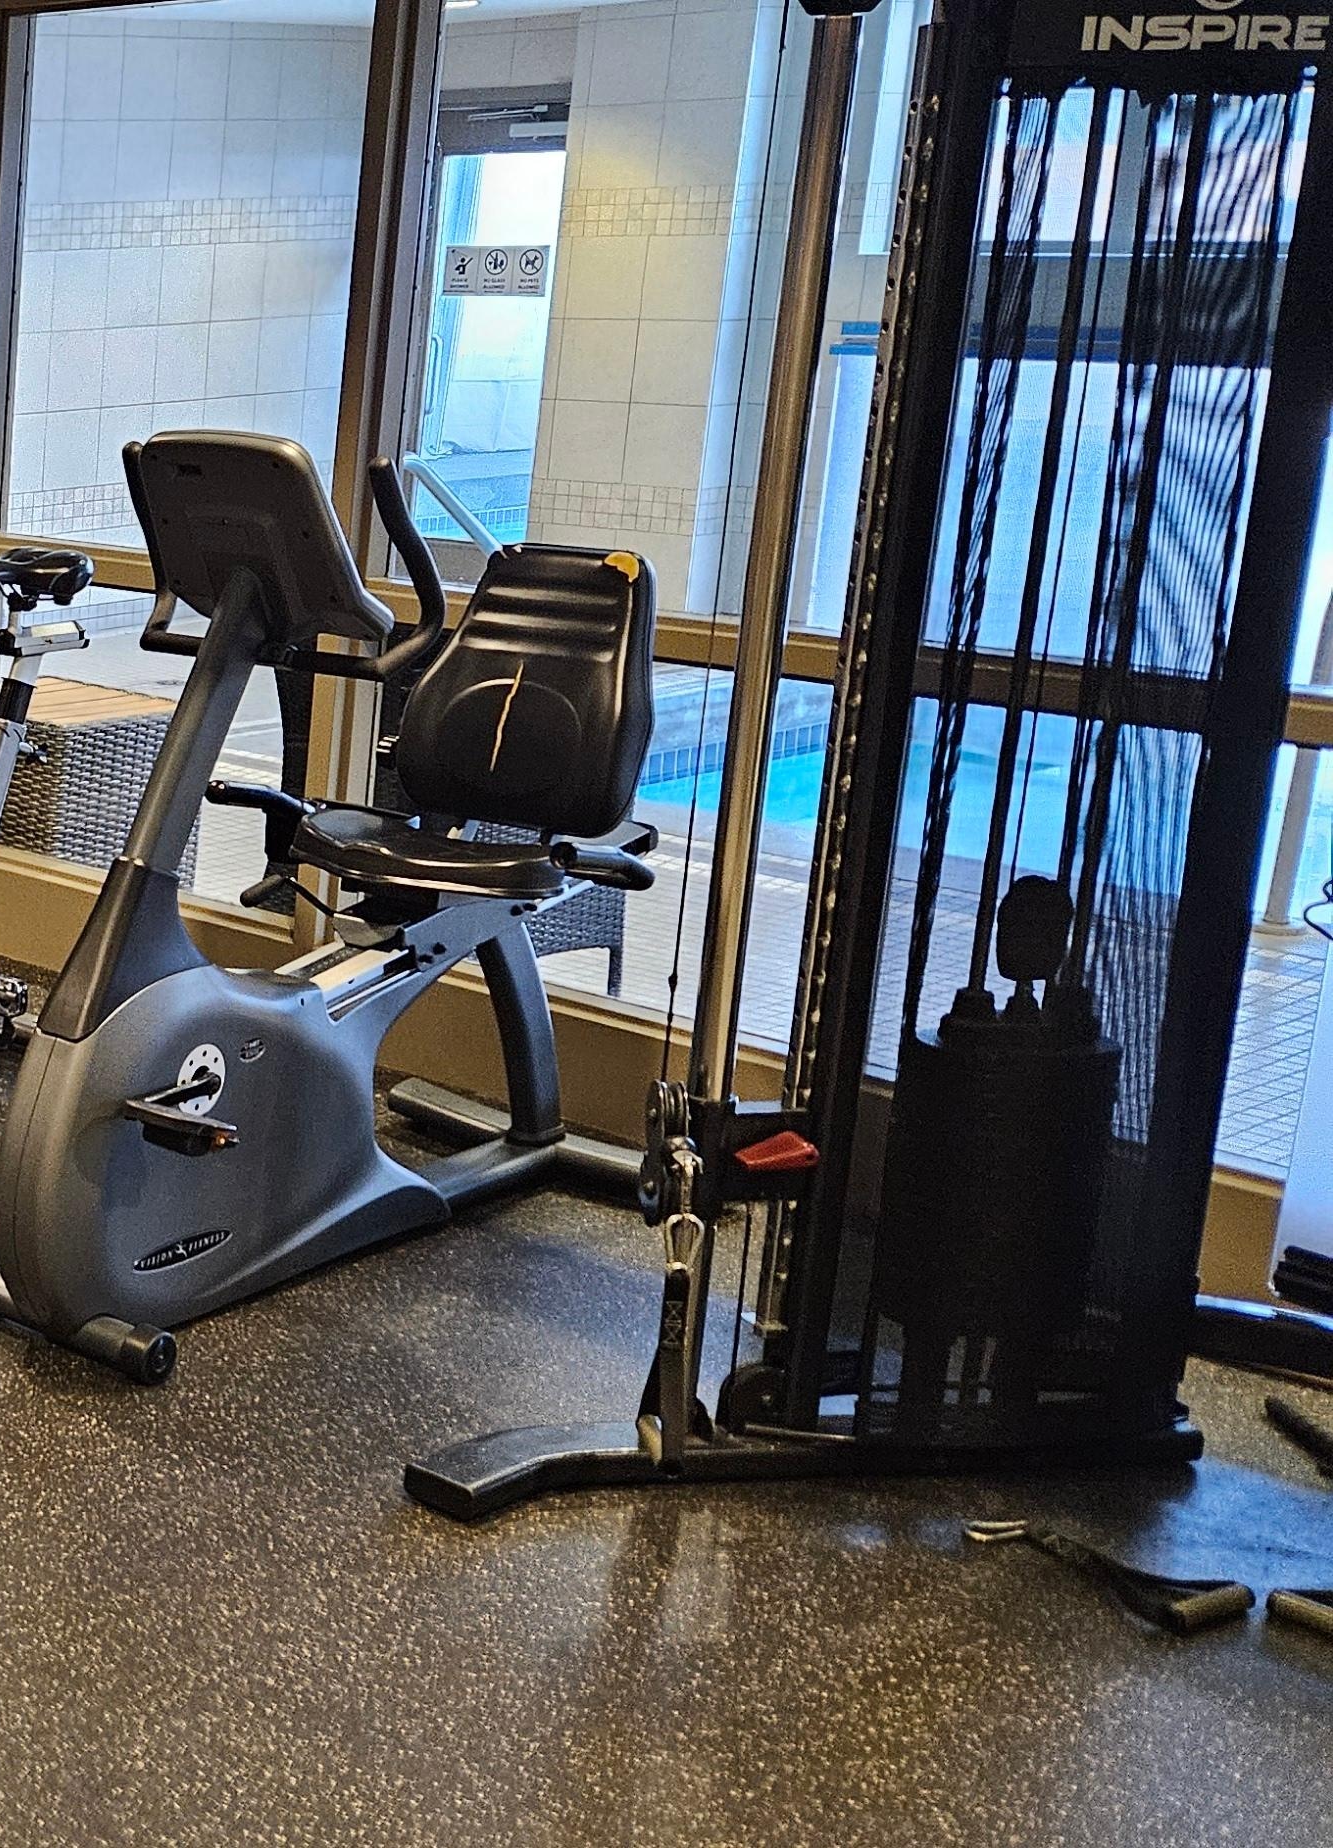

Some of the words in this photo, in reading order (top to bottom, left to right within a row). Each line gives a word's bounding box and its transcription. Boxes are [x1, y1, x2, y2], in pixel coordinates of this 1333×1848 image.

[1080, 15, 1330, 51] INSPIRE
[140, 1251, 173, 1268] VISION
[188, 1231, 225, 1252] FITNESS
